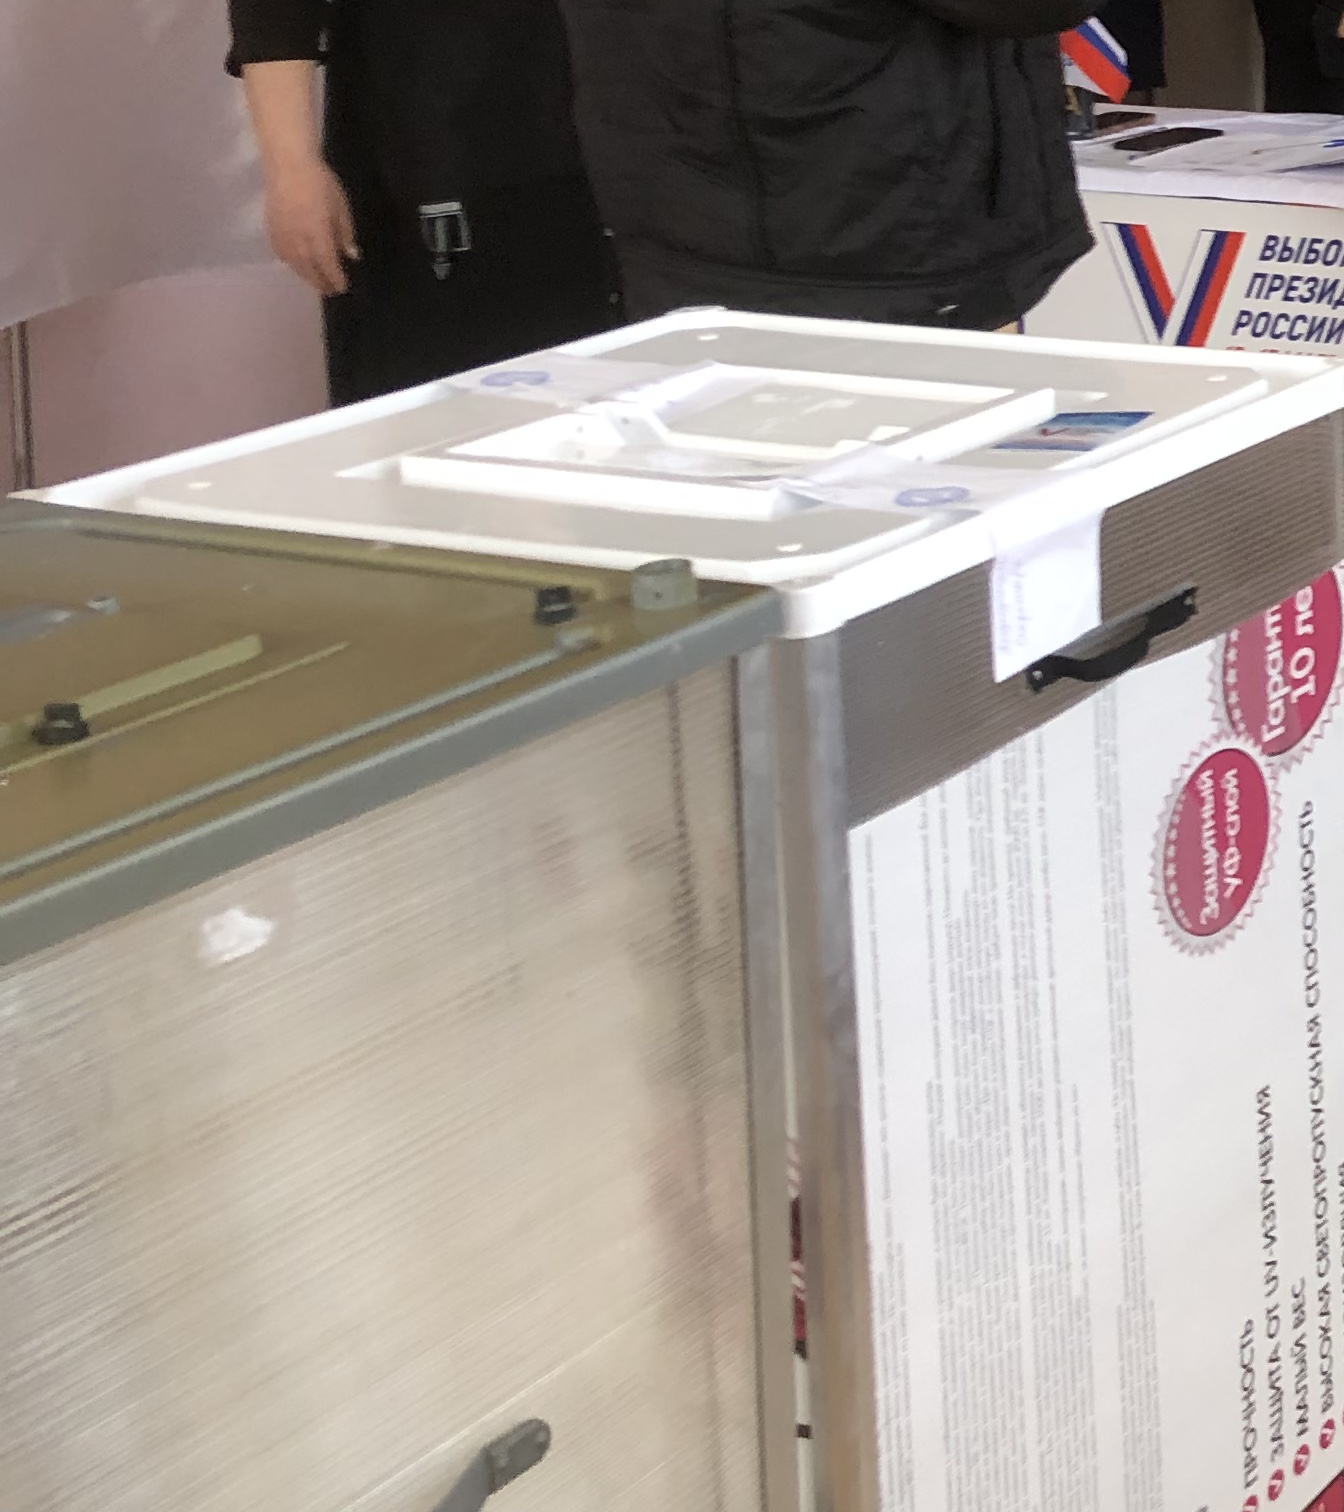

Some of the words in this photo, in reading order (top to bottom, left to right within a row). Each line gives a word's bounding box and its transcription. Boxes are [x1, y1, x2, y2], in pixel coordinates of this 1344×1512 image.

[1260, 603, 1291, 744] Гарант
[1289, 646, 1317, 704] 10
[1291, 586, 1315, 636] ле
[1198, 769, 1220, 925] Защитный
[1220, 768, 1243, 898] УФ-слой
[1299, 800, 1321, 1008] СПОСОБНОСТЬ
[1255, 1084, 1280, 1297] UV-ИЗЛУЧЕНИЯ
[1306, 1014, 1328, 1277] СВЕТОПРОПУСКНАЯ
[1265, 1302, 1280, 1339] ОТ
[1290, 1277, 1306, 1329] ВЕС
[1316, 1283, 1334, 1414] ВЫСОКАЯ
[1238, 1319, 1258, 1488] ПРОЧНОСТЬ
[1267, 1344, 1285, 1461] ЗАЩИТА
[1290, 1334, 1309, 1437] МАЛЫЙ
